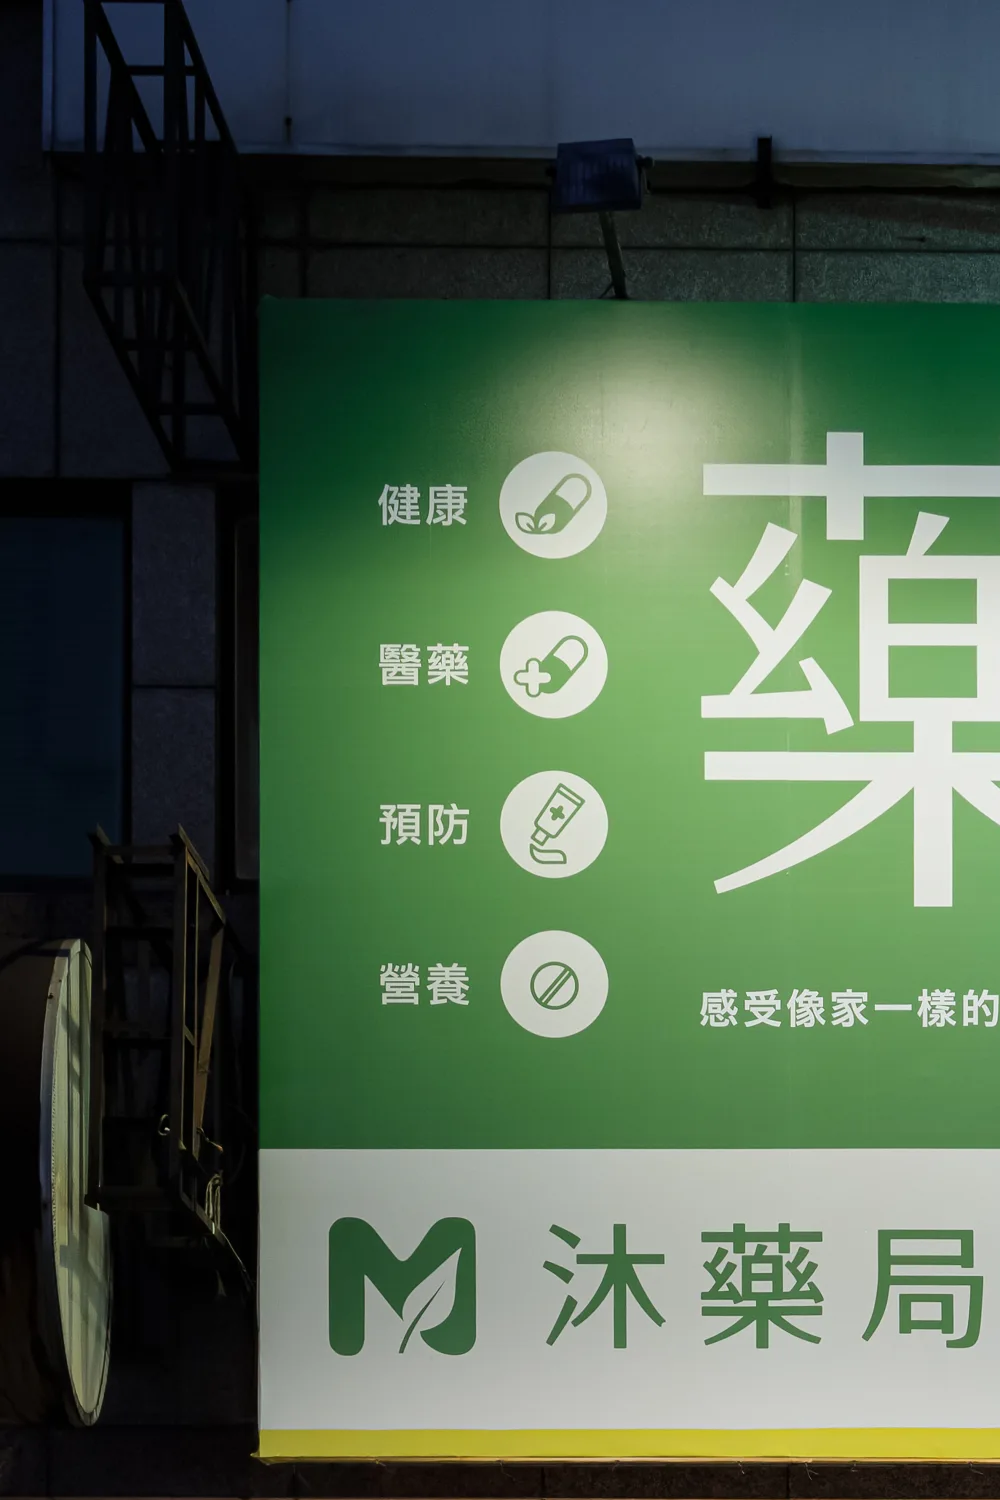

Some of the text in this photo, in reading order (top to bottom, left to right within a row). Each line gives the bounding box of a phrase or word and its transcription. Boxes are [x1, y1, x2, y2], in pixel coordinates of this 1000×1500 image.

[377, 483, 469, 527] 健康
[379, 643, 470, 687] 醫藥
[379, 803, 470, 846] 預防
[379, 962, 471, 1006] 營養
[543, 1223, 986, 1350] 沐藥局
